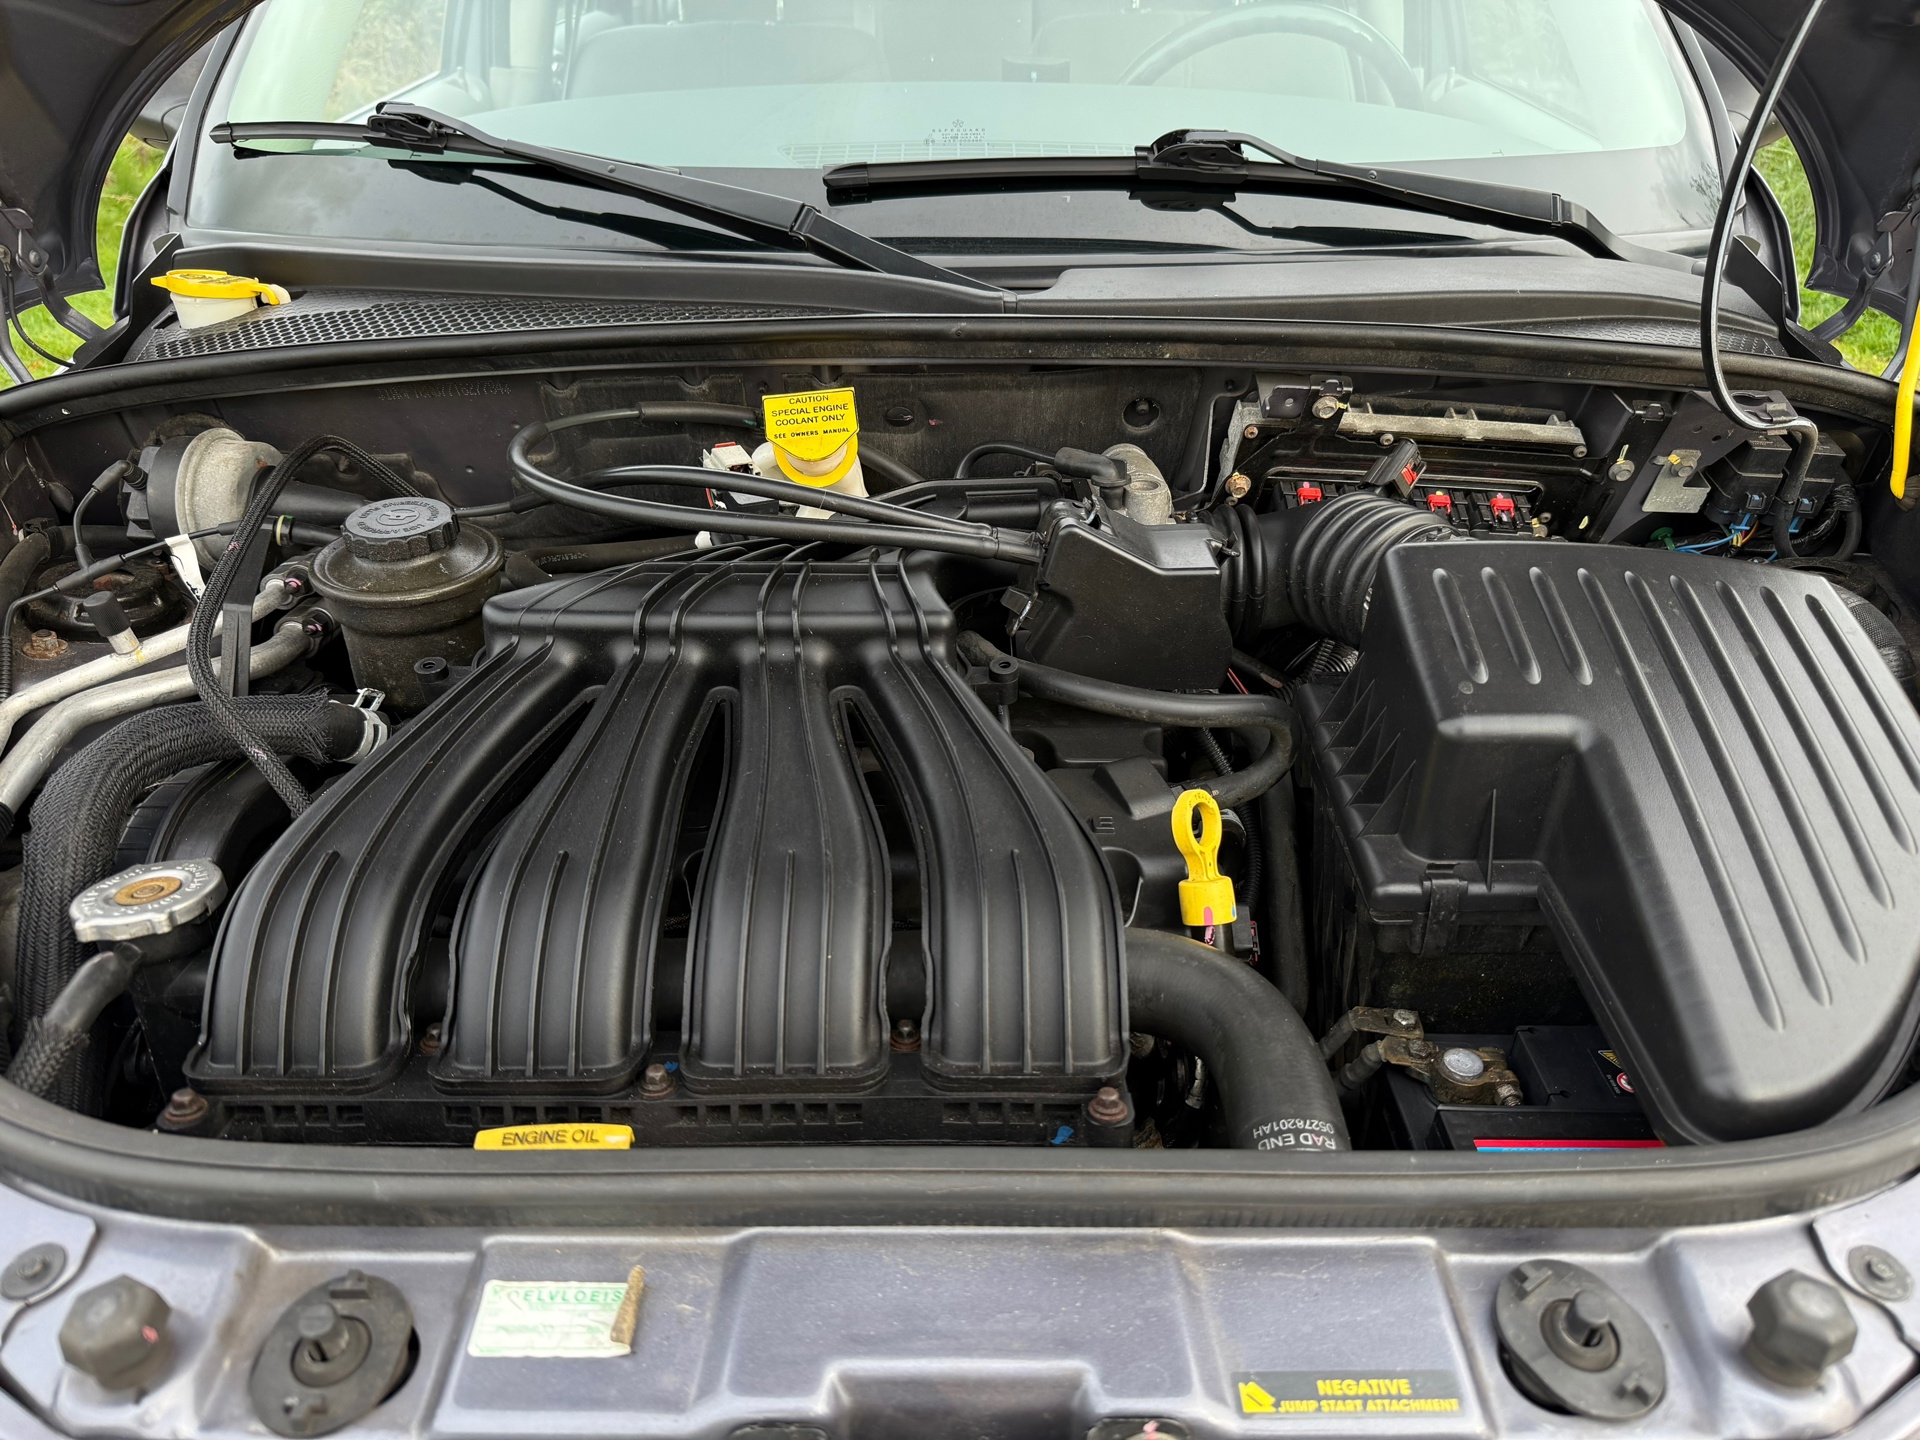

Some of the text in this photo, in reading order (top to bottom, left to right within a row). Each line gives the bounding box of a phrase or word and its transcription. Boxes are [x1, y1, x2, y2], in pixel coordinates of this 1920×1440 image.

[789, 395, 829, 405] CAUTION
[771, 403, 849, 417] SPECIAL ENGINE
[775, 413, 845, 427] COOLANT ONLY
[790, 430, 819, 438] OWNERS
[823, 427, 850, 435] MANUAL
[1253, 1118, 1334, 1138] 05278201AH
[501, 1129, 599, 1146] ENGINE OIL
[1258, 1133, 1336, 1150] RAD END
[1316, 1379, 1412, 1396] NEGATIVE
[1278, 1398, 1460, 1413] JUMP START ATTACHMENT
